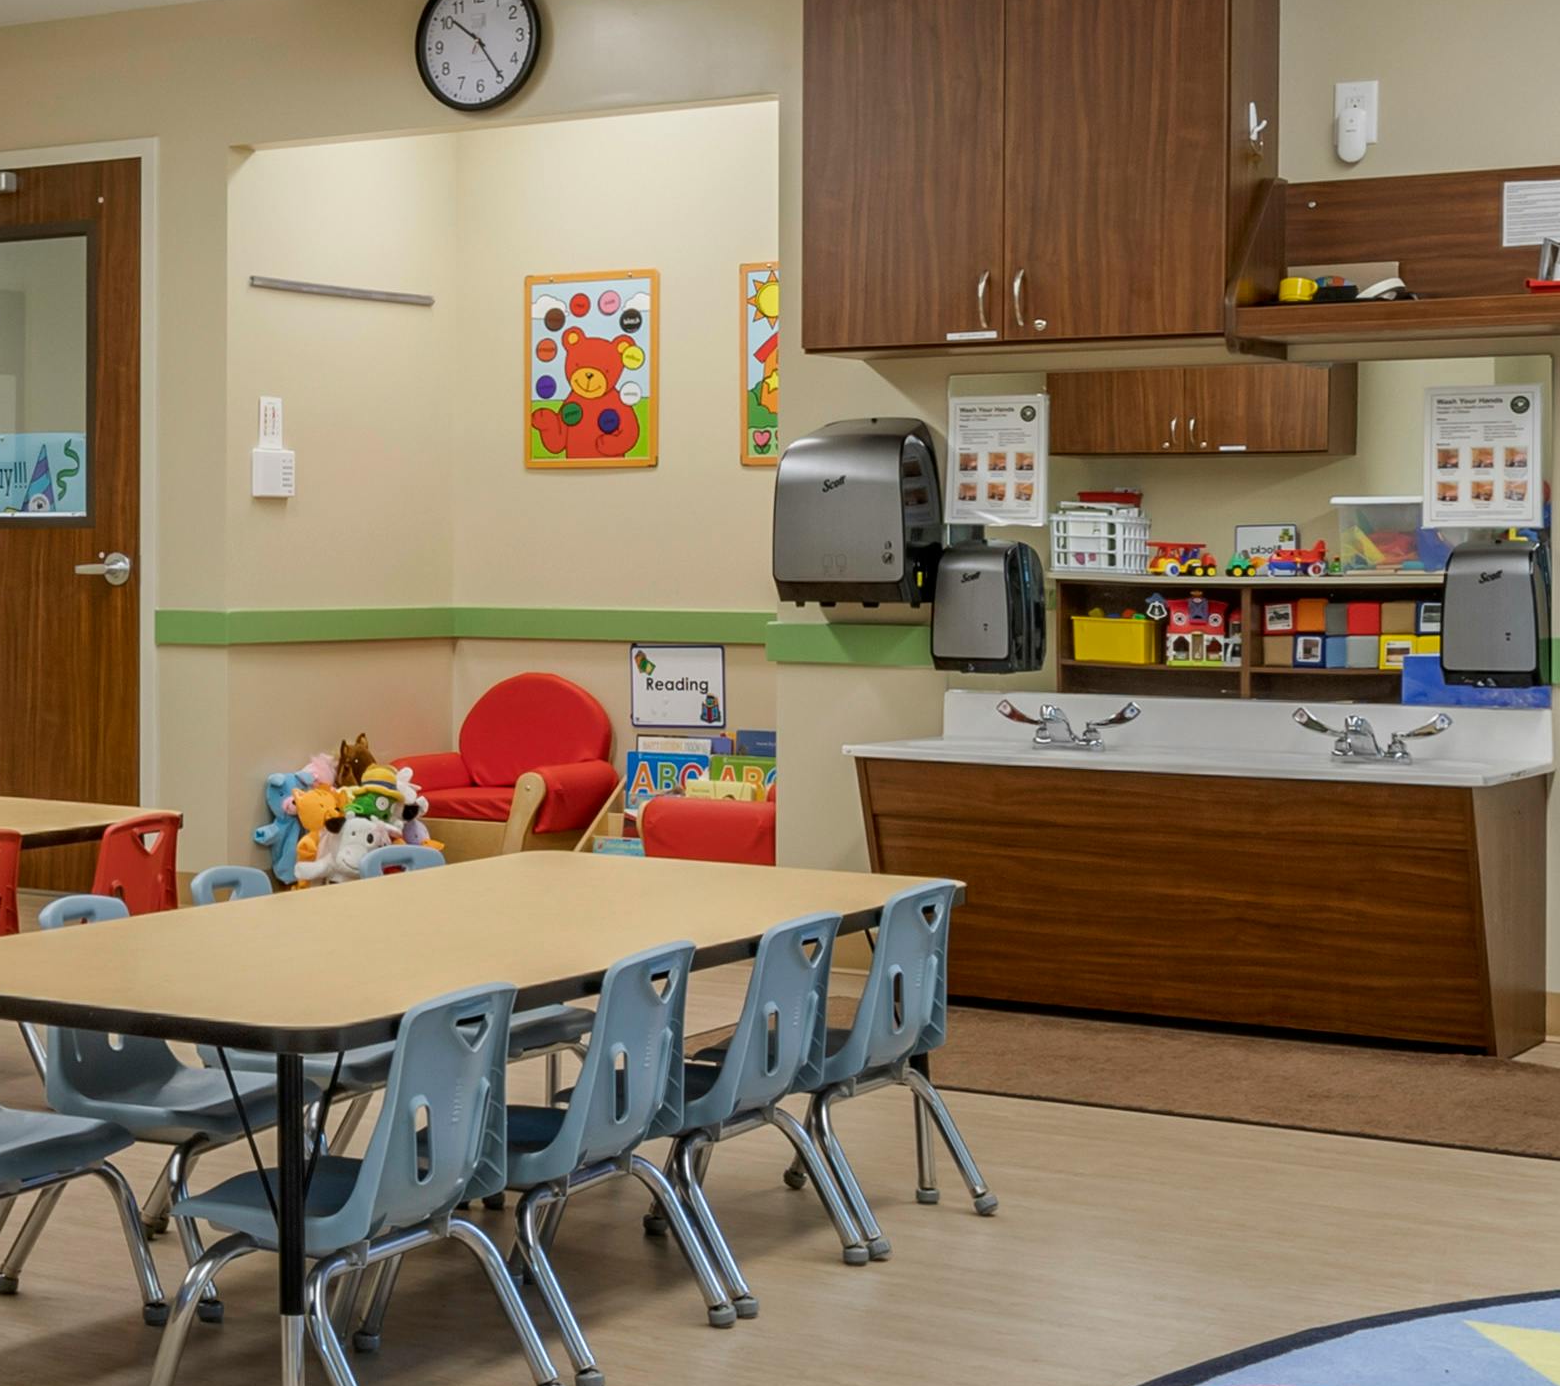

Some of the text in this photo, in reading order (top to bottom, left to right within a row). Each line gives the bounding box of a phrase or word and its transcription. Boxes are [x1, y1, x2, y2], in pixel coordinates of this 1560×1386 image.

[452, 0, 465, 14] 11
[508, 5, 518, 20] 2
[440, 16, 454, 30] 10
[515, 28, 525, 42] 3
[435, 41, 444, 55] 9
[510, 52, 519, 65] 4
[441, 61, 451, 76] 8
[457, 76, 466, 90] 7
[495, 70, 505, 84] 5
[476, 79, 485, 93] 6
[623, 317, 640, 325] black
[822, 475, 846, 493] Scott
[961, 571, 981, 583] Scott
[1479, 570, 1503, 583] Scott
[646, 677, 709, 694] Reading
